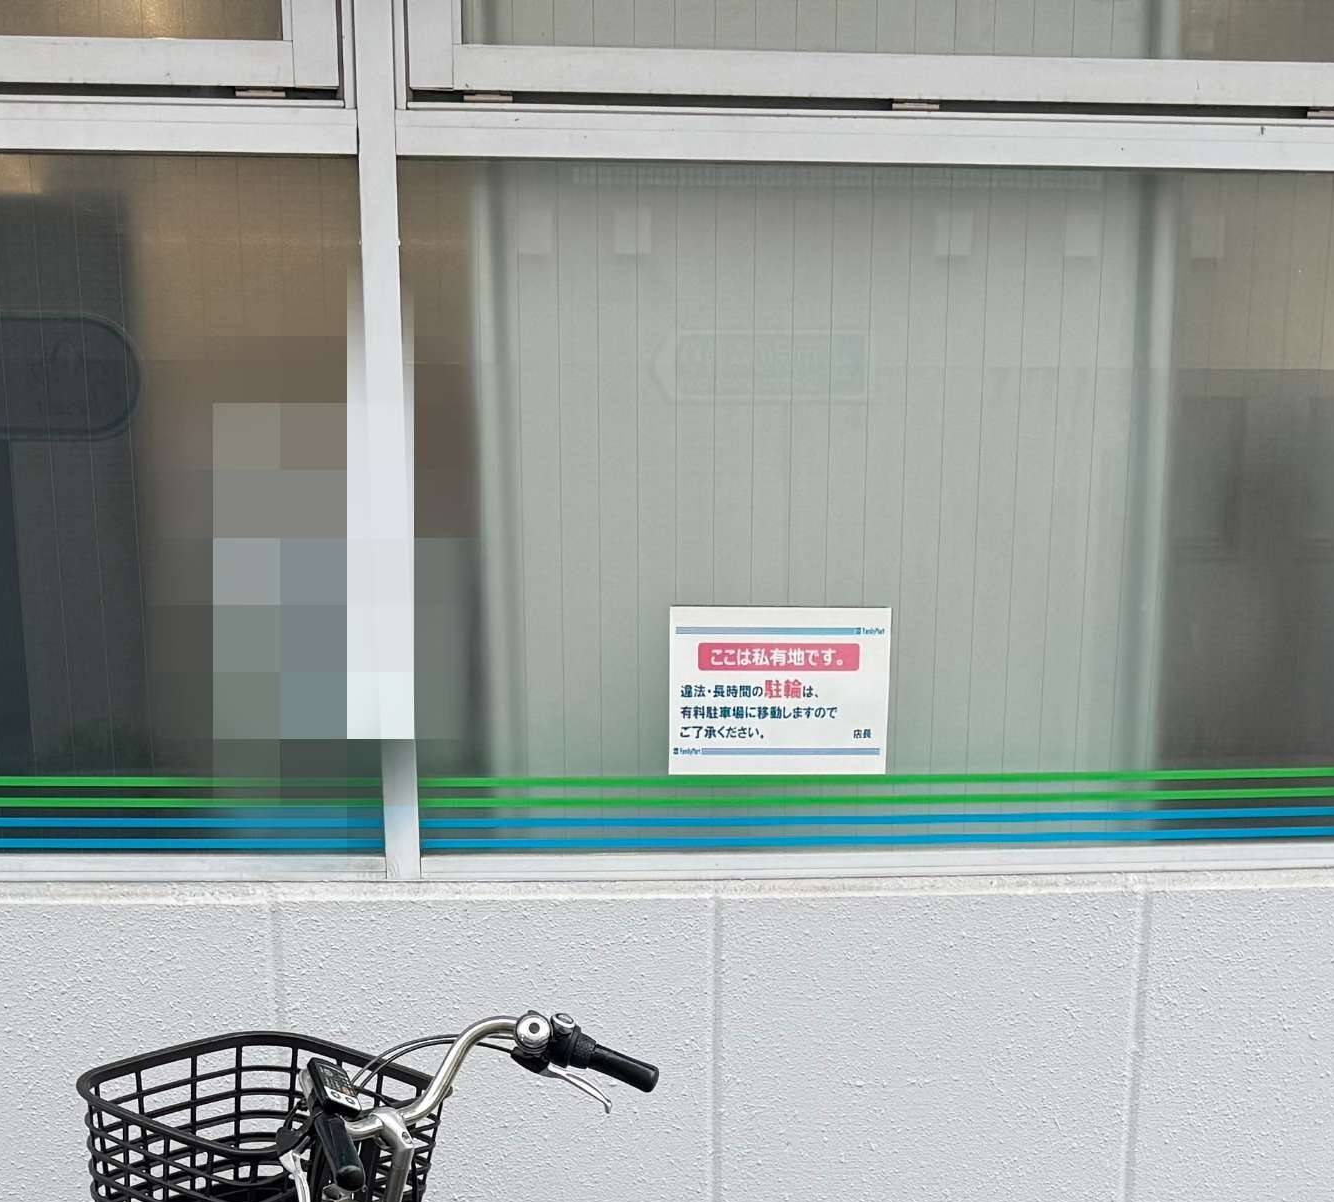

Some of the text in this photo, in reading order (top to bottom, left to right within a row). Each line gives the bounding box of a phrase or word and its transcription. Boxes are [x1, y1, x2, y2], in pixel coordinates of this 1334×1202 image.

[710, 648, 844, 667] ここは私有地です。
[680, 679, 819, 699] 違法・長時間の駐輪は、
[680, 705, 838, 720] 有料駐車場に移動しますので
[679, 725, 765, 739] ご了承ください。
[853, 728, 871, 739] 店長
